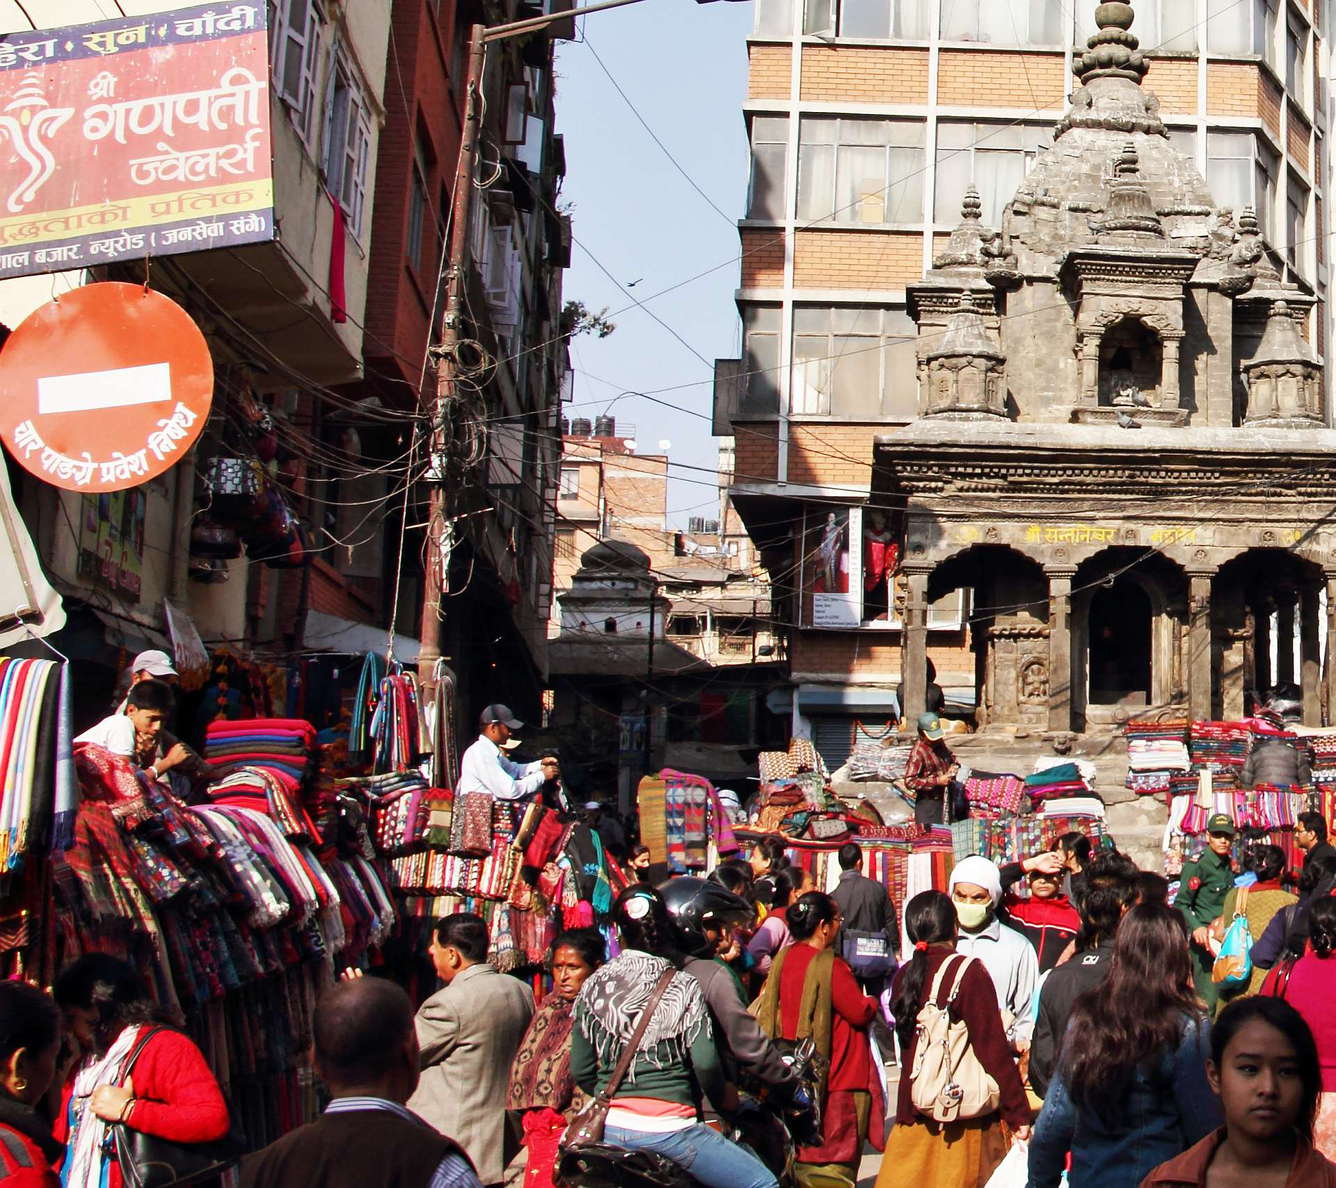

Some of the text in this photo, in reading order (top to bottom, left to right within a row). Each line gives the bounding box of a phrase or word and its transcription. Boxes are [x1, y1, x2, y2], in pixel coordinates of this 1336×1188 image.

[82, 25, 149, 55] सुन
[87, 71, 118, 101] श्री
[83, 66, 267, 144] गणपती
[129, 128, 264, 185] ज्वेलर्स
[149, 188, 254, 218] प्रतिक
[89, 232, 146, 257] न्यूरोड
[162, 221, 225, 245] जनसेवा
[14, 419, 44, 459] चार
[99, 448, 149, 483] प्रवेश
[147, 402, 198, 461] निषेध
